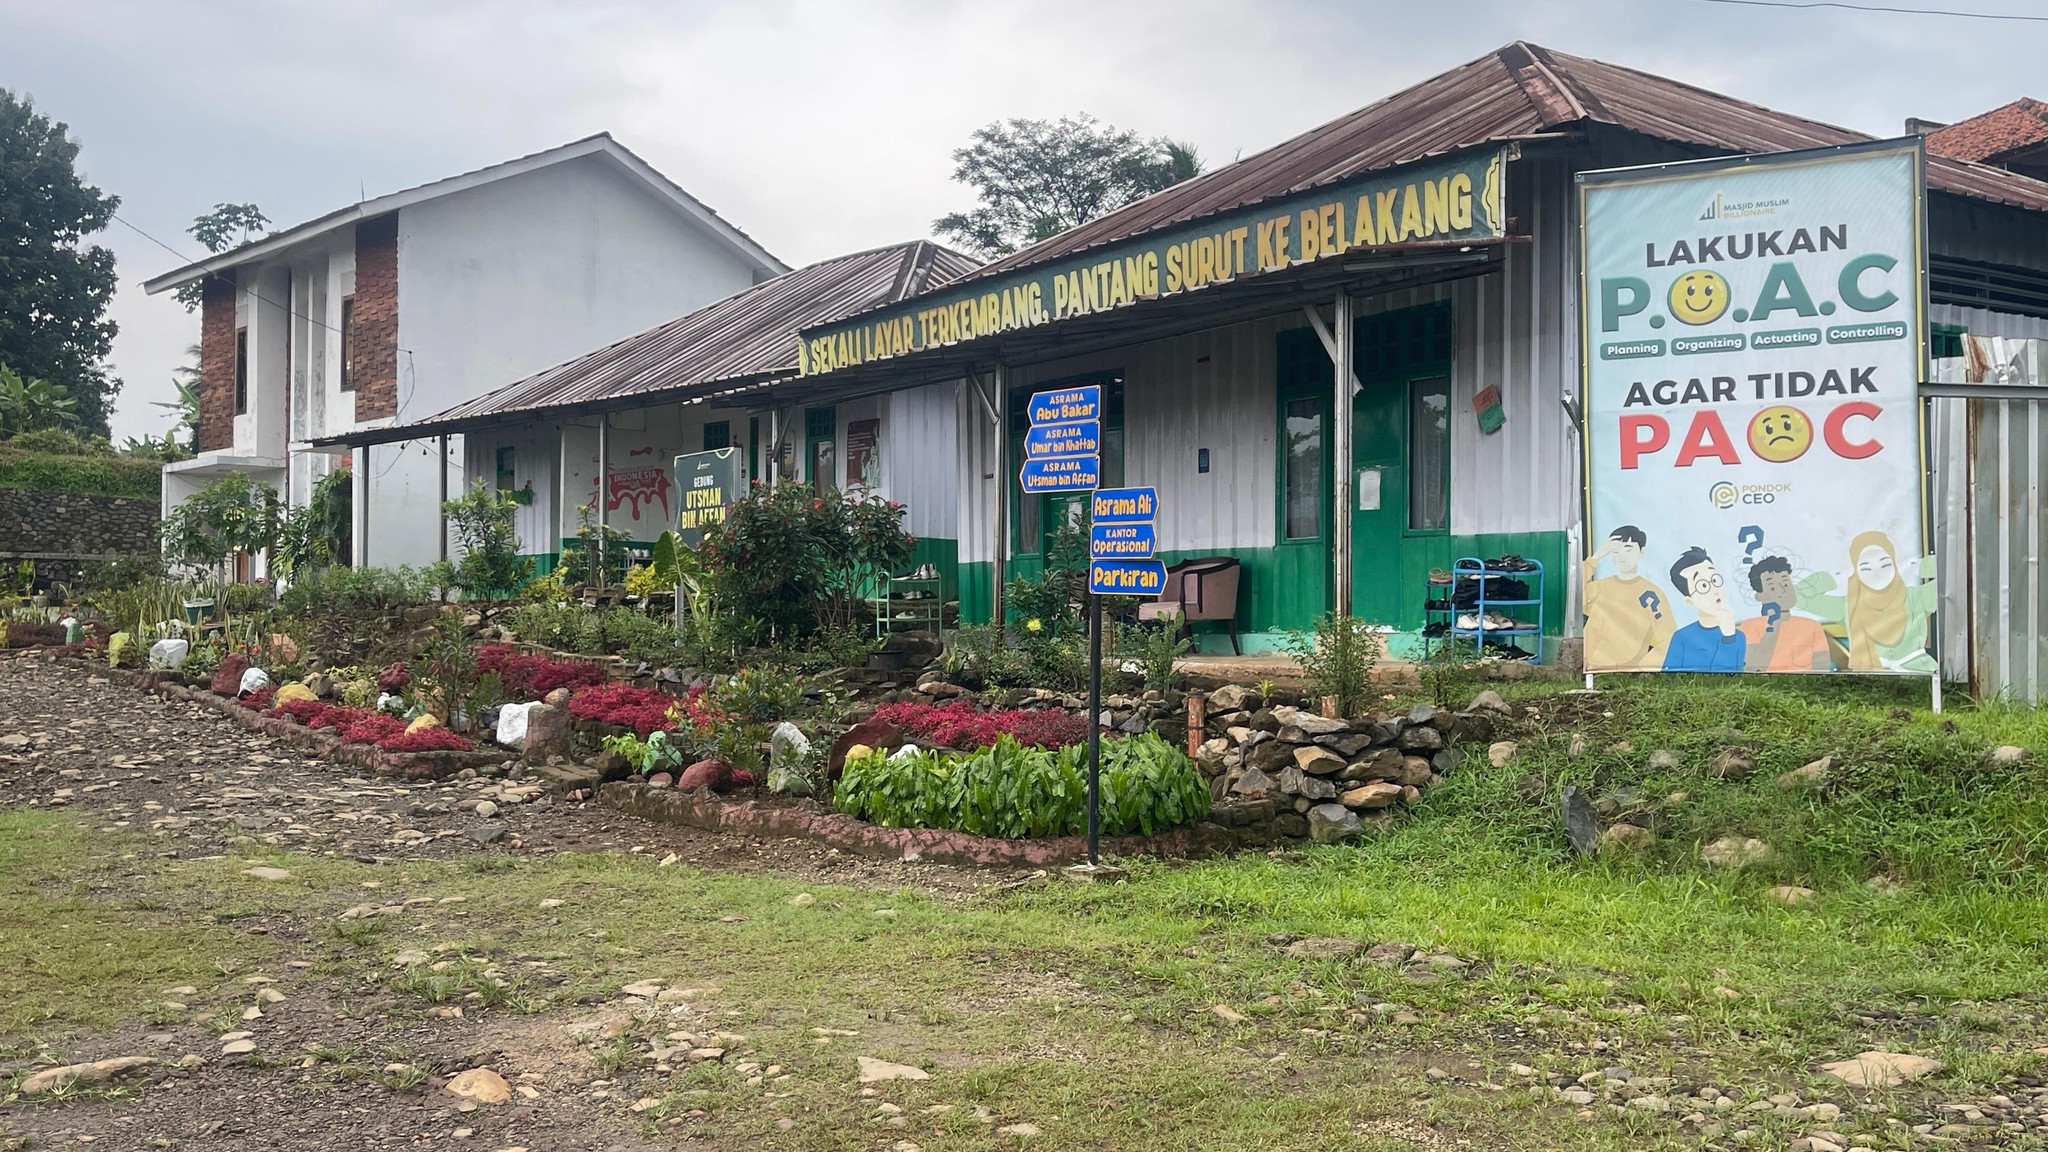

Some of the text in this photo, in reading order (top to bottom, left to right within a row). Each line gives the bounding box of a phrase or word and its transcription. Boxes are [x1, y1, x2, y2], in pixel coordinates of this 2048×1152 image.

[1723, 198, 1790, 211] MASJID MUSLIM
[1723, 207, 1776, 219] BILLIONAIRE
[1646, 224, 1847, 268] LAKUKAN
[811, 329, 863, 375] SEKALI
[865, 313, 914, 361] LAYAR
[1053, 251, 1159, 319] PANTANG
[1166, 226, 1248, 293] SURUT
[1256, 215, 1292, 272] KE
[1300, 173, 1472, 262] BELAKANG
[1607, 325, 1904, 358] Planning Organizing Actuating Controlling
[1623, 366, 1879, 408] AGAR TIDAK
[1049, 392, 1084, 405] ASRAMA
[1036, 403, 1096, 421] Abu Bakar
[1045, 427, 1082, 439] ASRAMA
[1031, 437, 1096, 454] Umar bin Khattab
[1043, 461, 1081, 472] ASRAMA
[693, 474, 714, 488] GEDUNG
[1027, 472, 1096, 487] Utsman bin Affan
[1742, 482, 1792, 494] PONDOK
[686, 487, 721, 509] UTSMAN
[1094, 494, 1152, 516] Asrama Ali
[1742, 493, 1776, 505] CEO
[682, 510, 697, 530] BIN
[1105, 528, 1137, 538] KANTOR
[1093, 538, 1150, 555] Operasional
[1094, 566, 1158, 588] Parkiran
